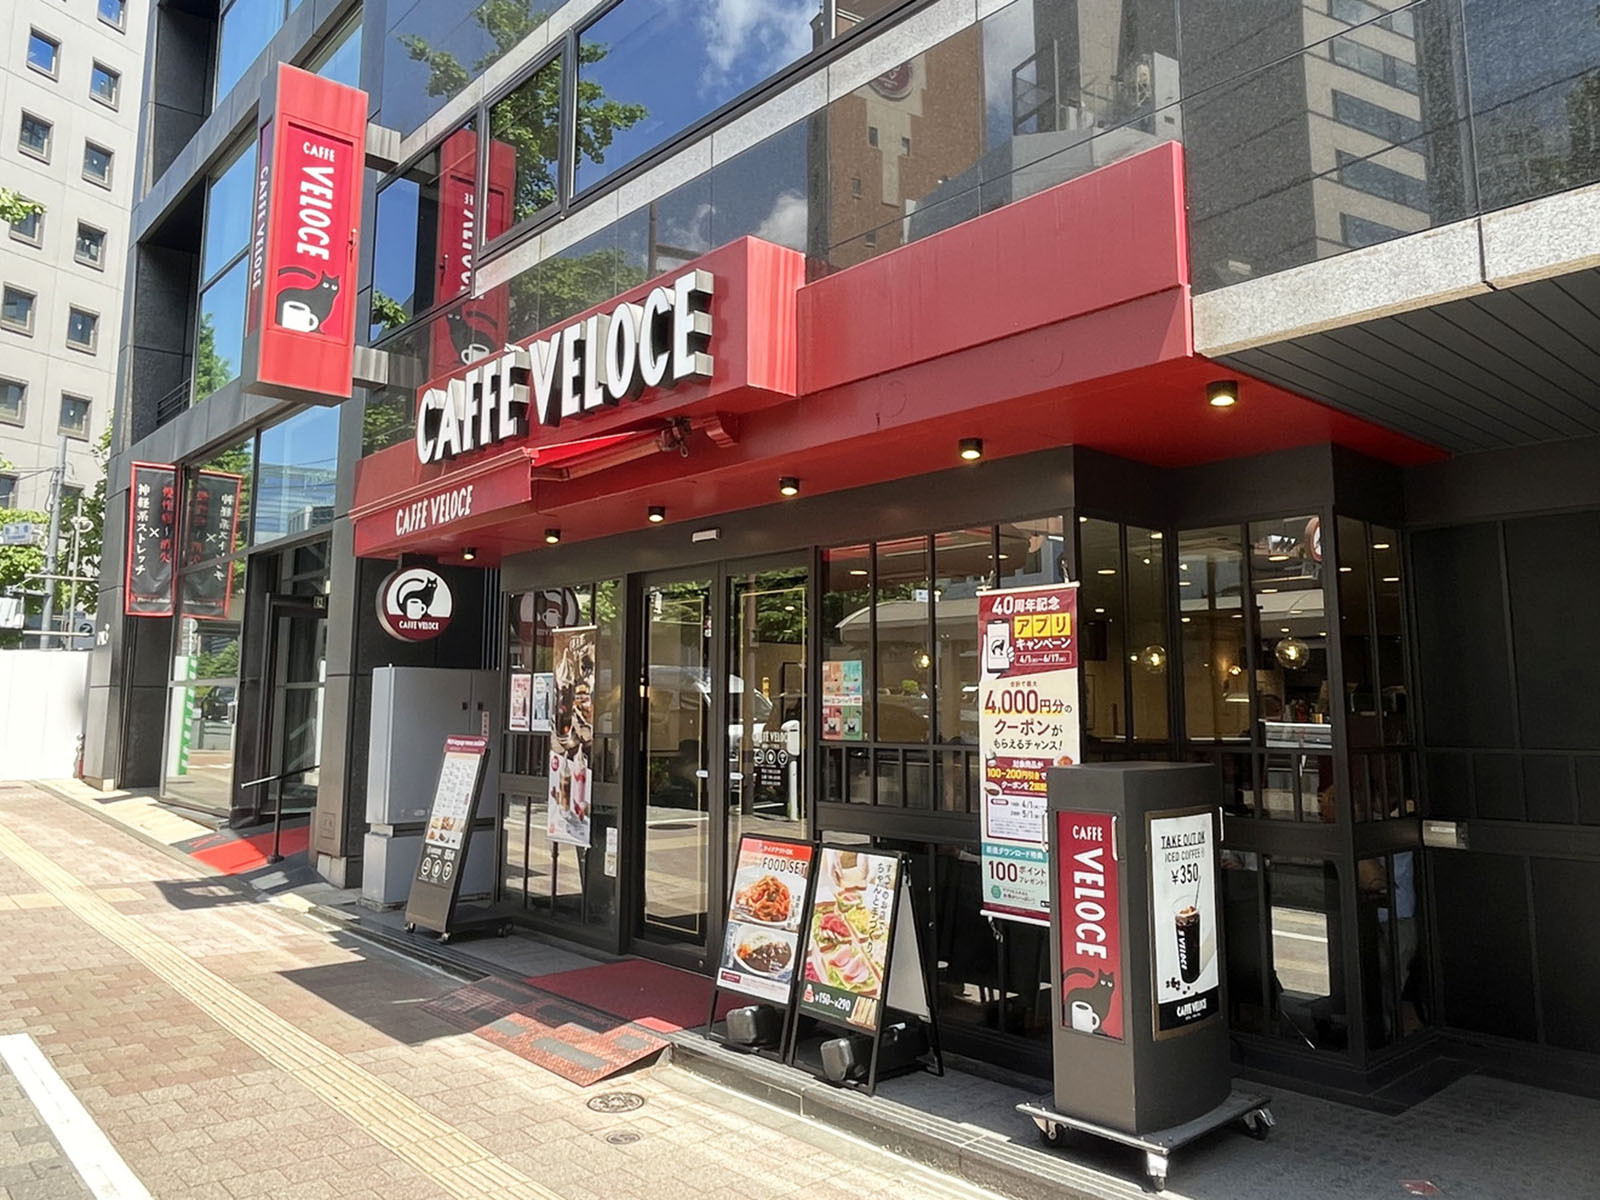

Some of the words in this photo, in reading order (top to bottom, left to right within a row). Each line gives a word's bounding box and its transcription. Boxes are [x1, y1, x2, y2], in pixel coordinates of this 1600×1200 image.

[303, 141, 335, 163] CAFFE
[297, 166, 335, 261] VELOCE
[253, 222, 266, 290] VELOCE
[529, 269, 713, 424] VELOCE
[431, 485, 473, 525] VELOCE
[992, 596, 1060, 616] 40周年記念
[1017, 616, 1067, 636] アプリ
[1016, 638, 1071, 652] キャンペーン
[985, 690, 1072, 715] 4,000円分の
[994, 719, 1063, 737] クーポンが
[1073, 825, 1103, 842] CAFFE
[1161, 834, 1181, 849] TAKE
[763, 857, 786, 872] FOOD
[789, 860, 808, 876] SET
[1165, 851, 1179, 863] ICED
[1181, 848, 1200, 860] COFFEE
[988, 860, 1018, 882] 100
[1171, 863, 1198, 885] ¥350
[1073, 847, 1108, 960] VELOCE
